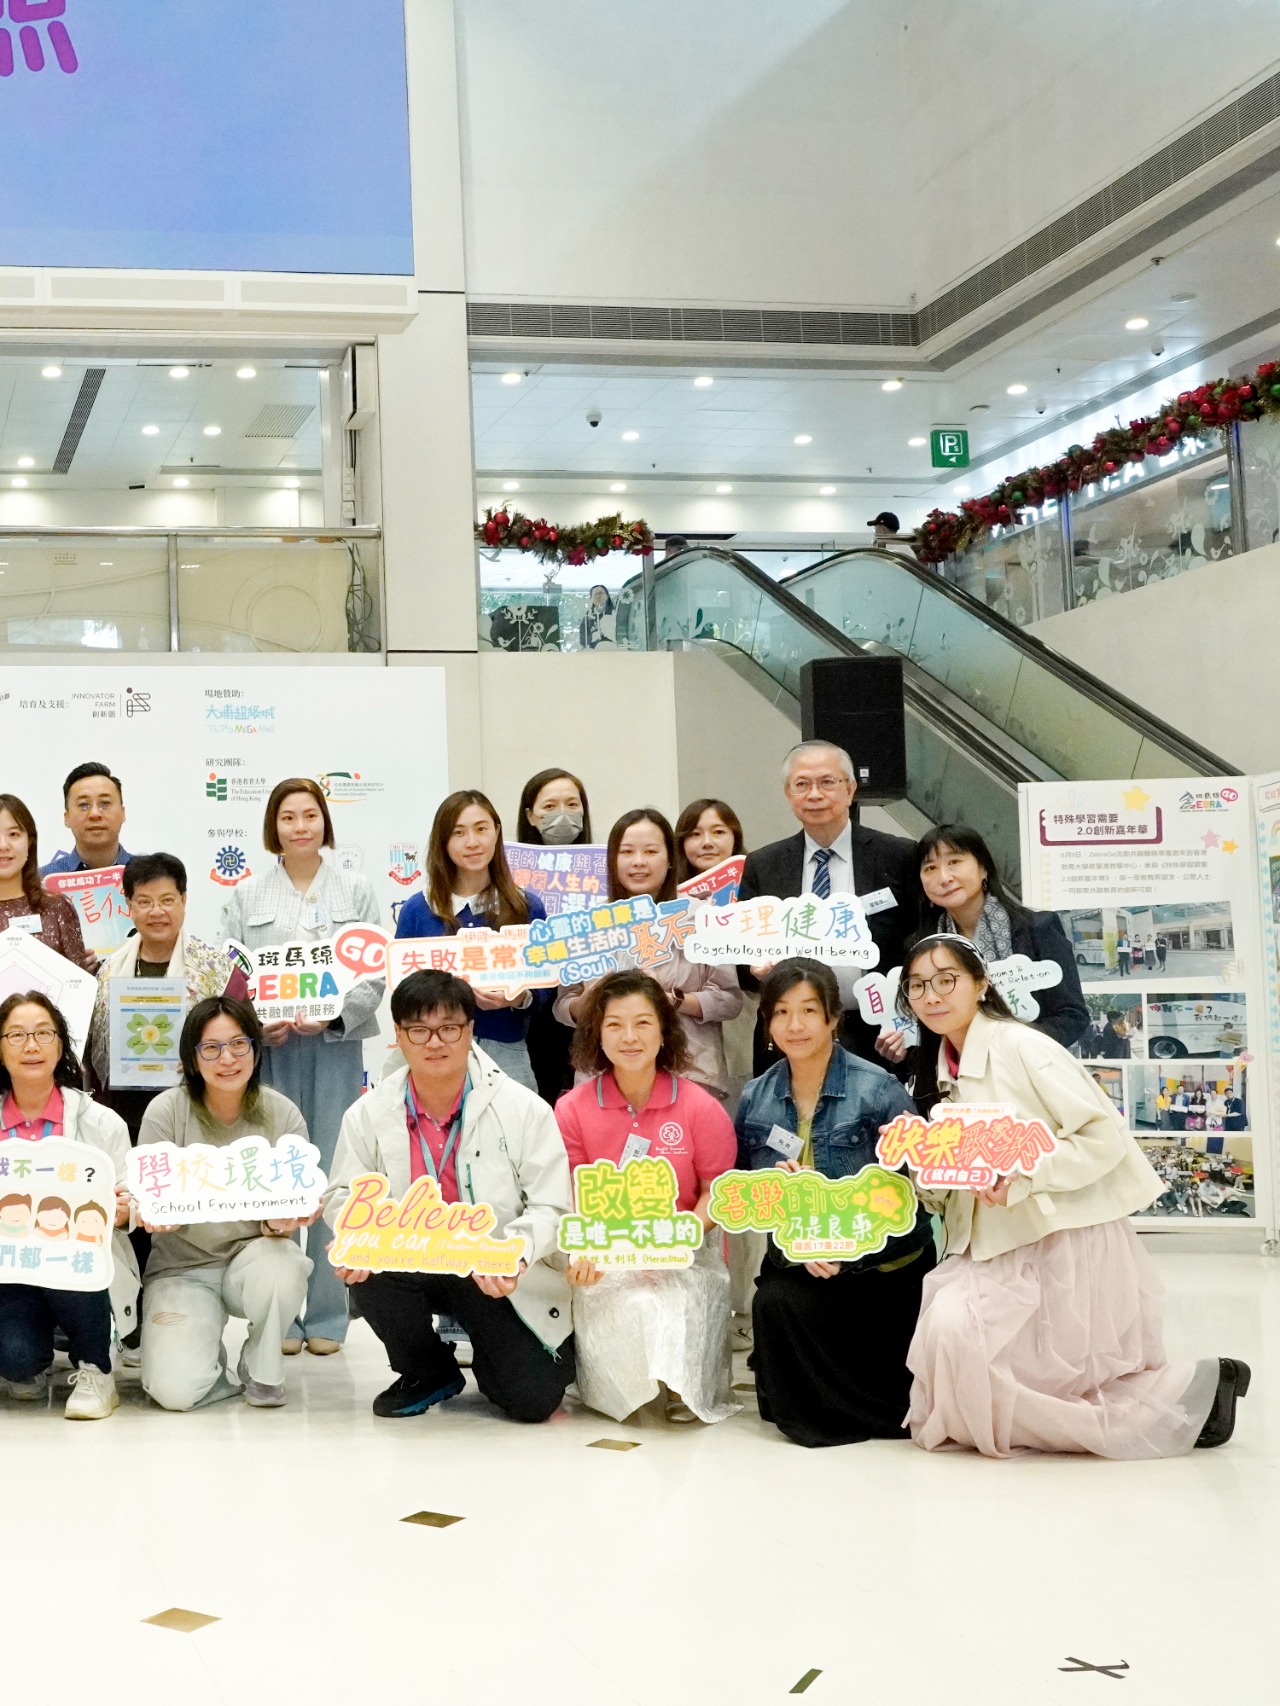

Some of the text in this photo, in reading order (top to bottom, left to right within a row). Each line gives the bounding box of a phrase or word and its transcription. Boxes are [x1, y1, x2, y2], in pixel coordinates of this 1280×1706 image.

[1053, 813, 1119, 824] 特殊學習需要
[1076, 824, 1149, 836] 2.0創新嘉年華
[531, 900, 654, 943] 心靈的健康是
[704, 902, 862, 943] 心理健康
[257, 945, 334, 967] 斑馬線
[340, 936, 384, 967] GO
[693, 942, 790, 959] Psychological
[138, 1143, 316, 1199] 學校環境
[150, 1195, 308, 1215] School Environment
[340, 1178, 491, 1232] Believe
[579, 1161, 673, 1220] 改變
[721, 1180, 854, 1220] 喜樂的心
[564, 1218, 698, 1247] 是唯一不變的
[786, 1212, 874, 1242] 乃是良藥
[335, 1230, 380, 1260] you
[391, 1233, 431, 1253] can
[349, 1253, 370, 1264] and
[477, 1258, 512, 1270] there
